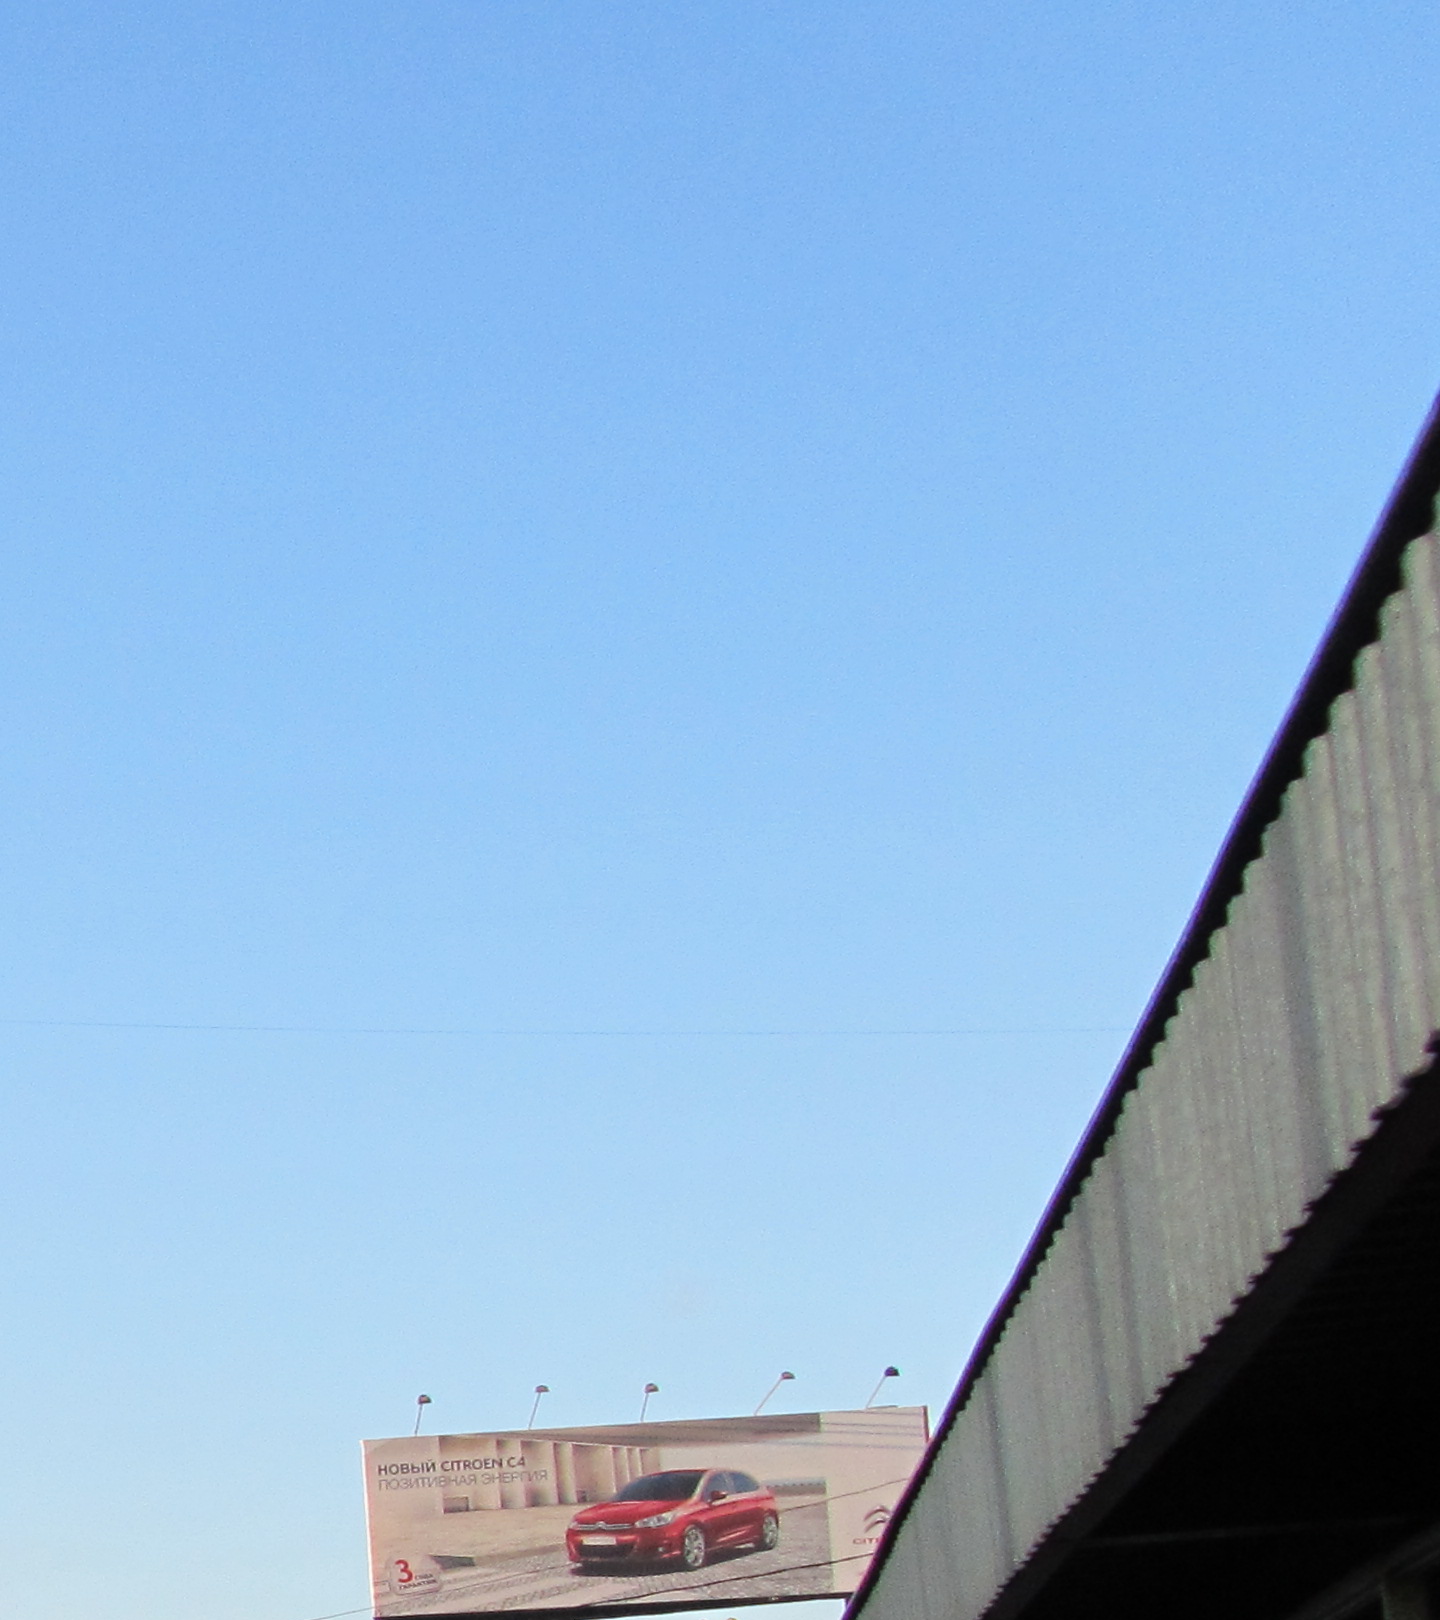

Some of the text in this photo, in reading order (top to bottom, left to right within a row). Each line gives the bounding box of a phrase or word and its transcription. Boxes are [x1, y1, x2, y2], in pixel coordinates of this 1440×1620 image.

[378, 1456, 526, 1476] НОВЫЙ CITROEN C4
[378, 1469, 548, 1491] ПОЗИТИВНАЯ ЭНЕРГИЯ
[395, 1559, 413, 1583] 3
